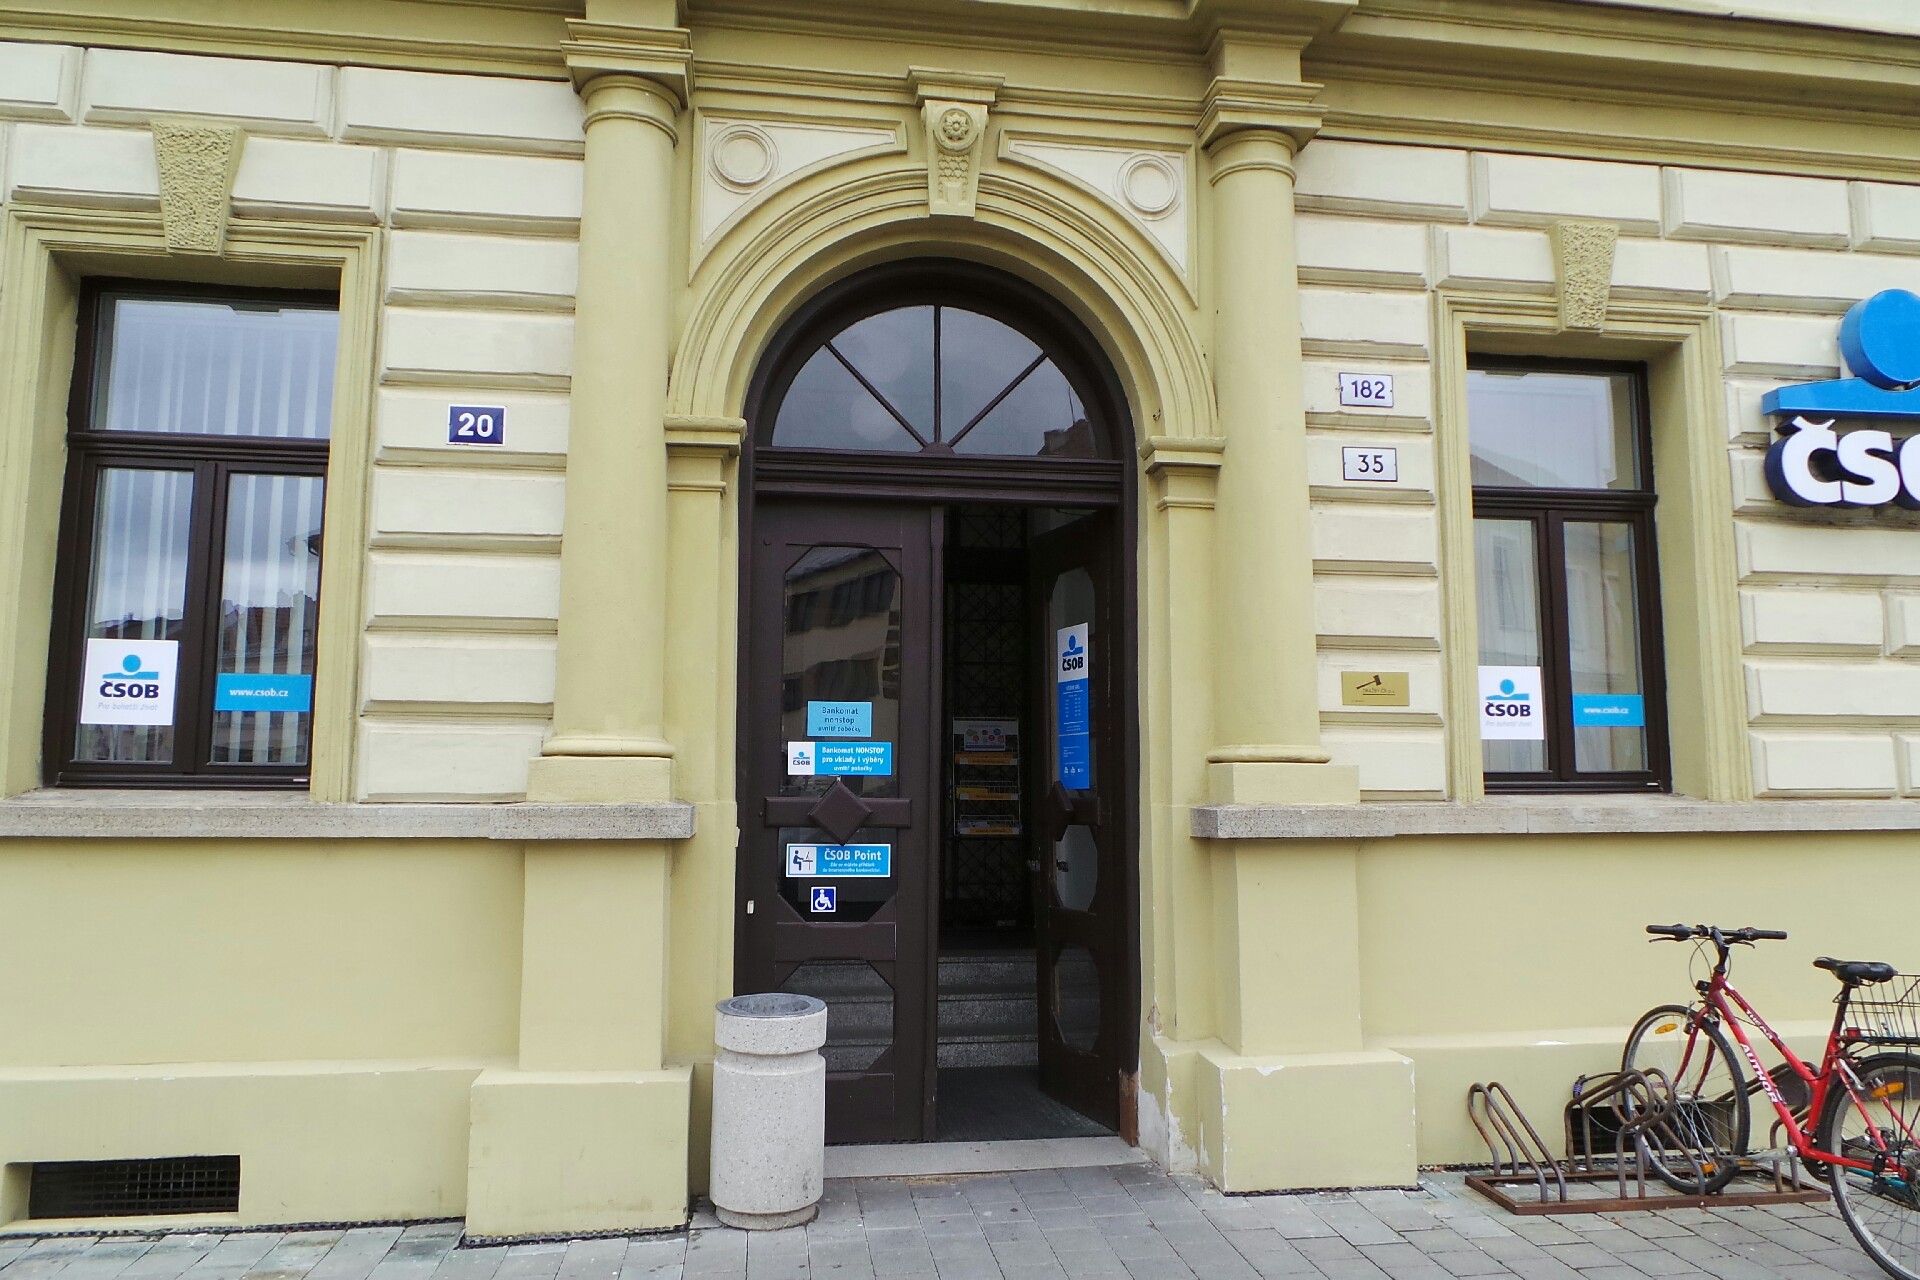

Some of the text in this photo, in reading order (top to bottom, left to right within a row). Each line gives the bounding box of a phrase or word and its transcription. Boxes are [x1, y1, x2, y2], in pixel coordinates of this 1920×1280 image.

[1351, 380, 1386, 399] 182
[457, 412, 494, 438] 20
[1357, 454, 1384, 473] 35
[1062, 657, 1084, 671] ČSOB
[99, 680, 159, 698] ČSOB
[229, 687, 289, 697] www.csob.cz
[822, 706, 859, 715] Bankomat
[1485, 702, 1531, 717] ČSOB
[824, 717, 855, 726] nonstop
[822, 746, 885, 754] Bankomat NONSTOP
[792, 758, 811, 766] ČSOB
[834, 756, 856, 765] vklady
[862, 756, 884, 765] výběry
[824, 848, 882, 861] ČSOB Point
[1740, 1043, 1779, 1103] AUTHOR
